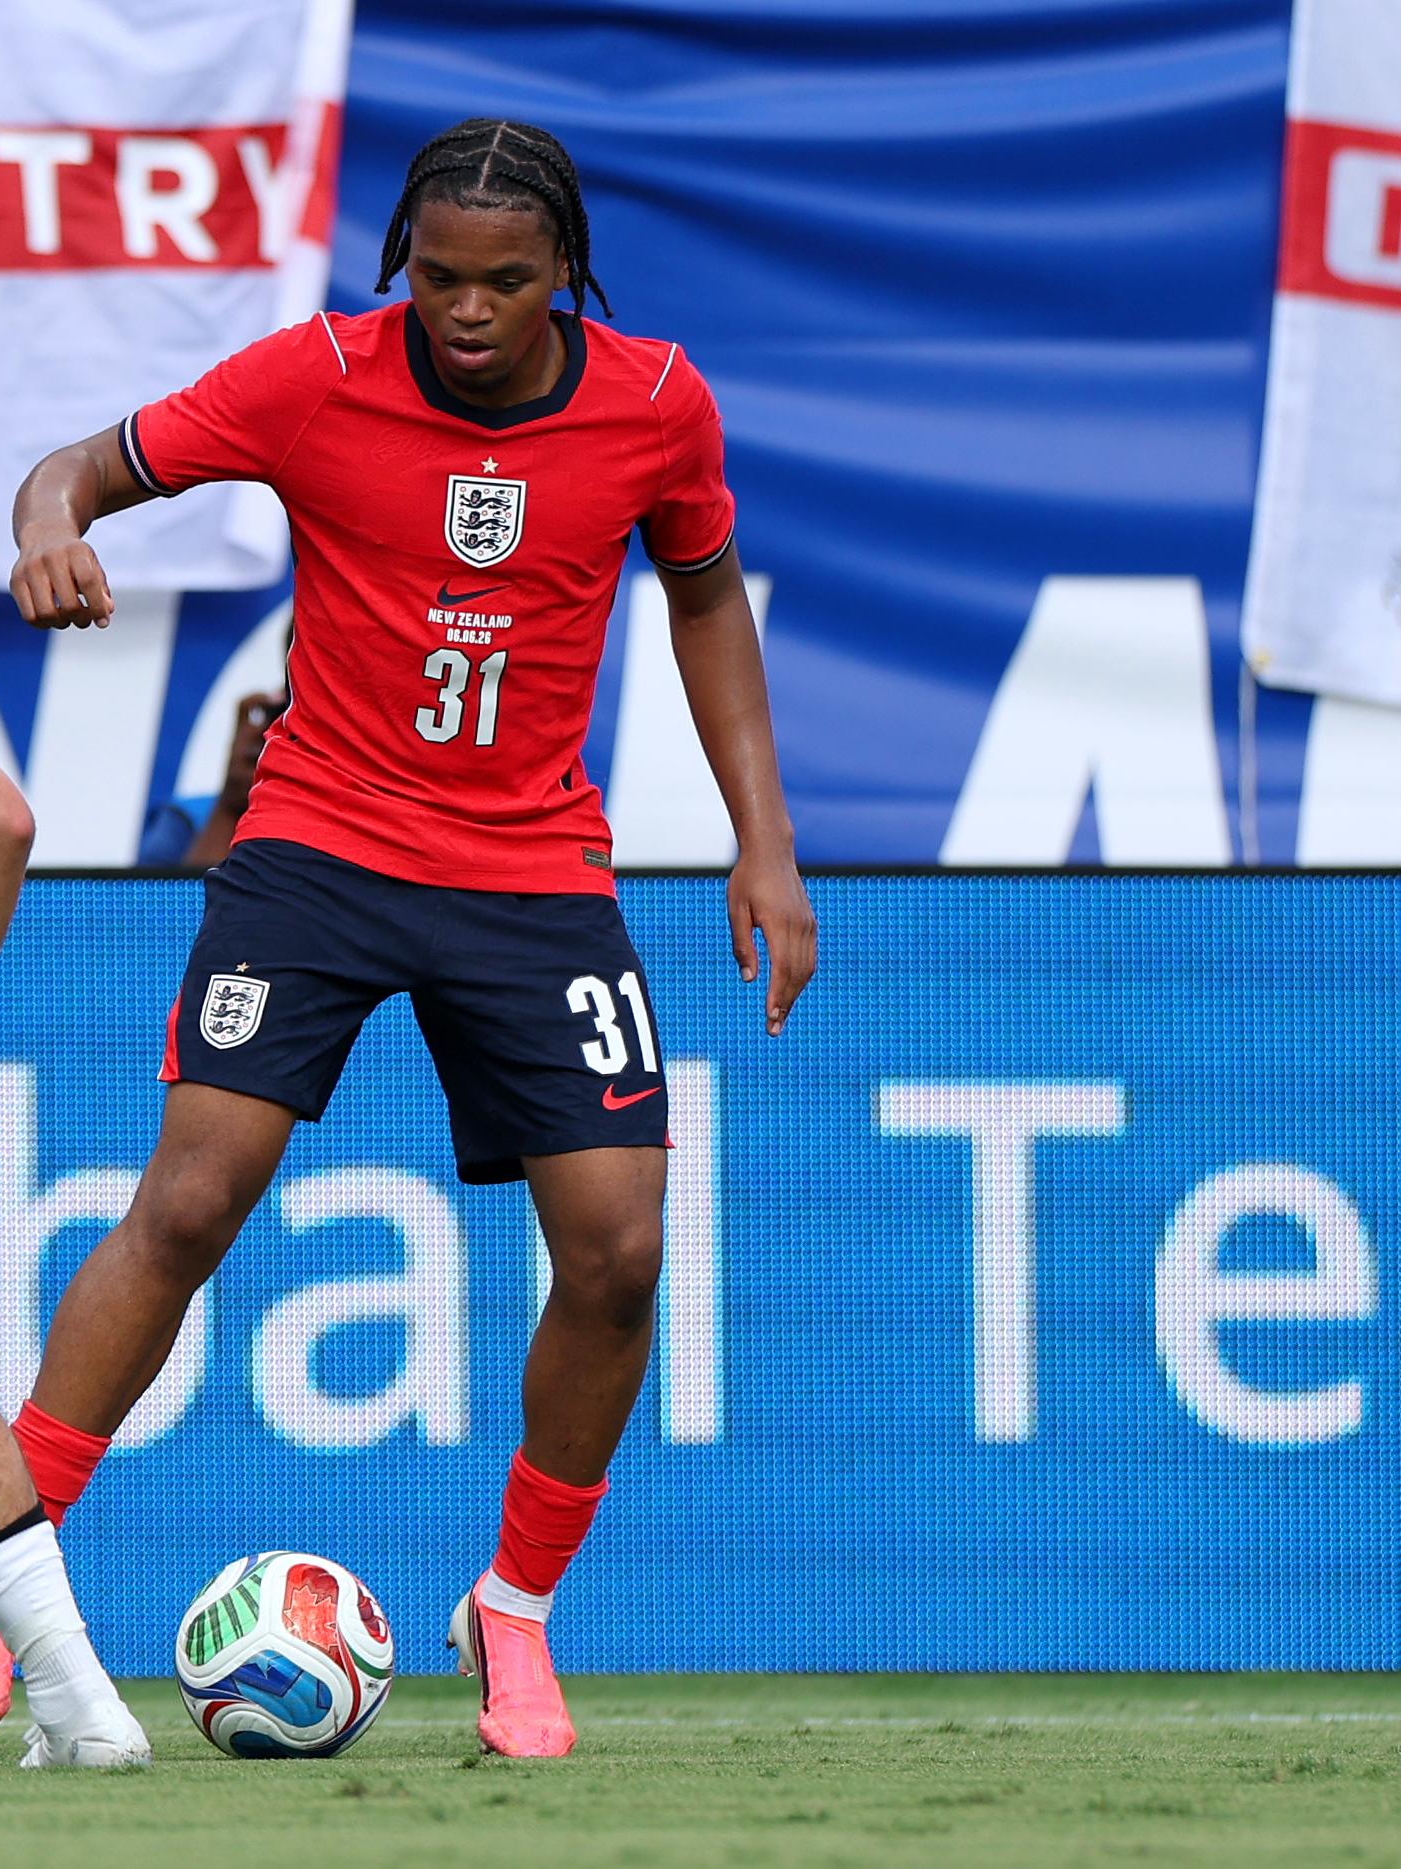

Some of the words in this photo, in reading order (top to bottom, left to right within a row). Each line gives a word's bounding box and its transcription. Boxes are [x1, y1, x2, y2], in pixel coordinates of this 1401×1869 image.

[427, 608, 456, 625] NEW
[457, 612, 513, 629] ZEALAND
[446, 628, 492, 645] 06.06.26
[414, 648, 507, 746] 31
[565, 971, 658, 1075] 31
[878, 1078, 1378, 1446] Te
